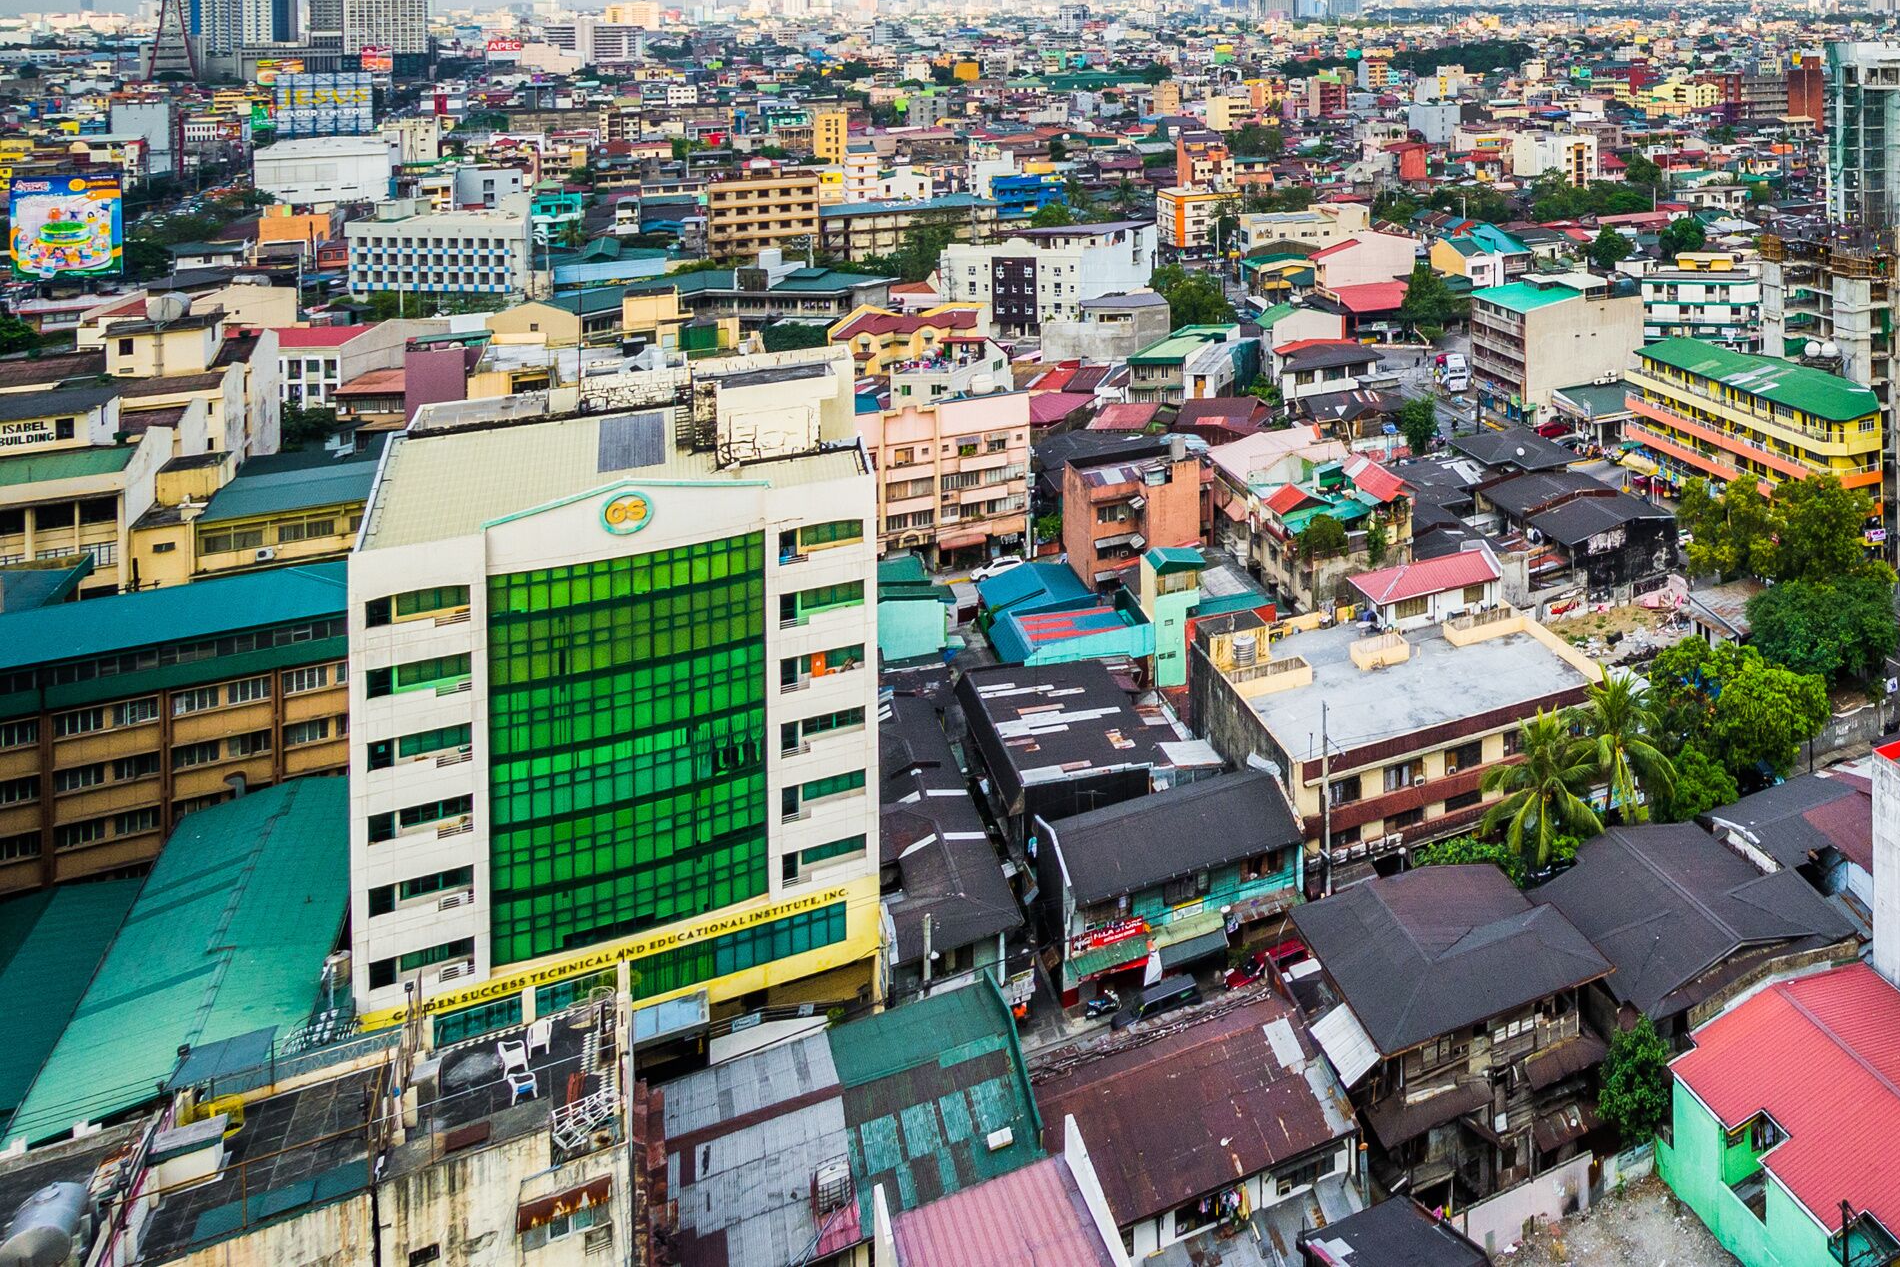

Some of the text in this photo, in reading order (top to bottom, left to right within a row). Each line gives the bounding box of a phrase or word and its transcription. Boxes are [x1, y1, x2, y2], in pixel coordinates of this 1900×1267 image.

[489, 42, 520, 50] APEC
[277, 88, 369, 109] JESUS
[290, 109, 318, 117] LORD
[2, 421, 48, 434] ISABEL
[0, 432, 54, 446] BUILDING
[606, 500, 647, 524] GS
[393, 888, 850, 1021] GDEN SUCCESS TECHNICAL AND EDUCATIONAL INSTITUTE, INC.
